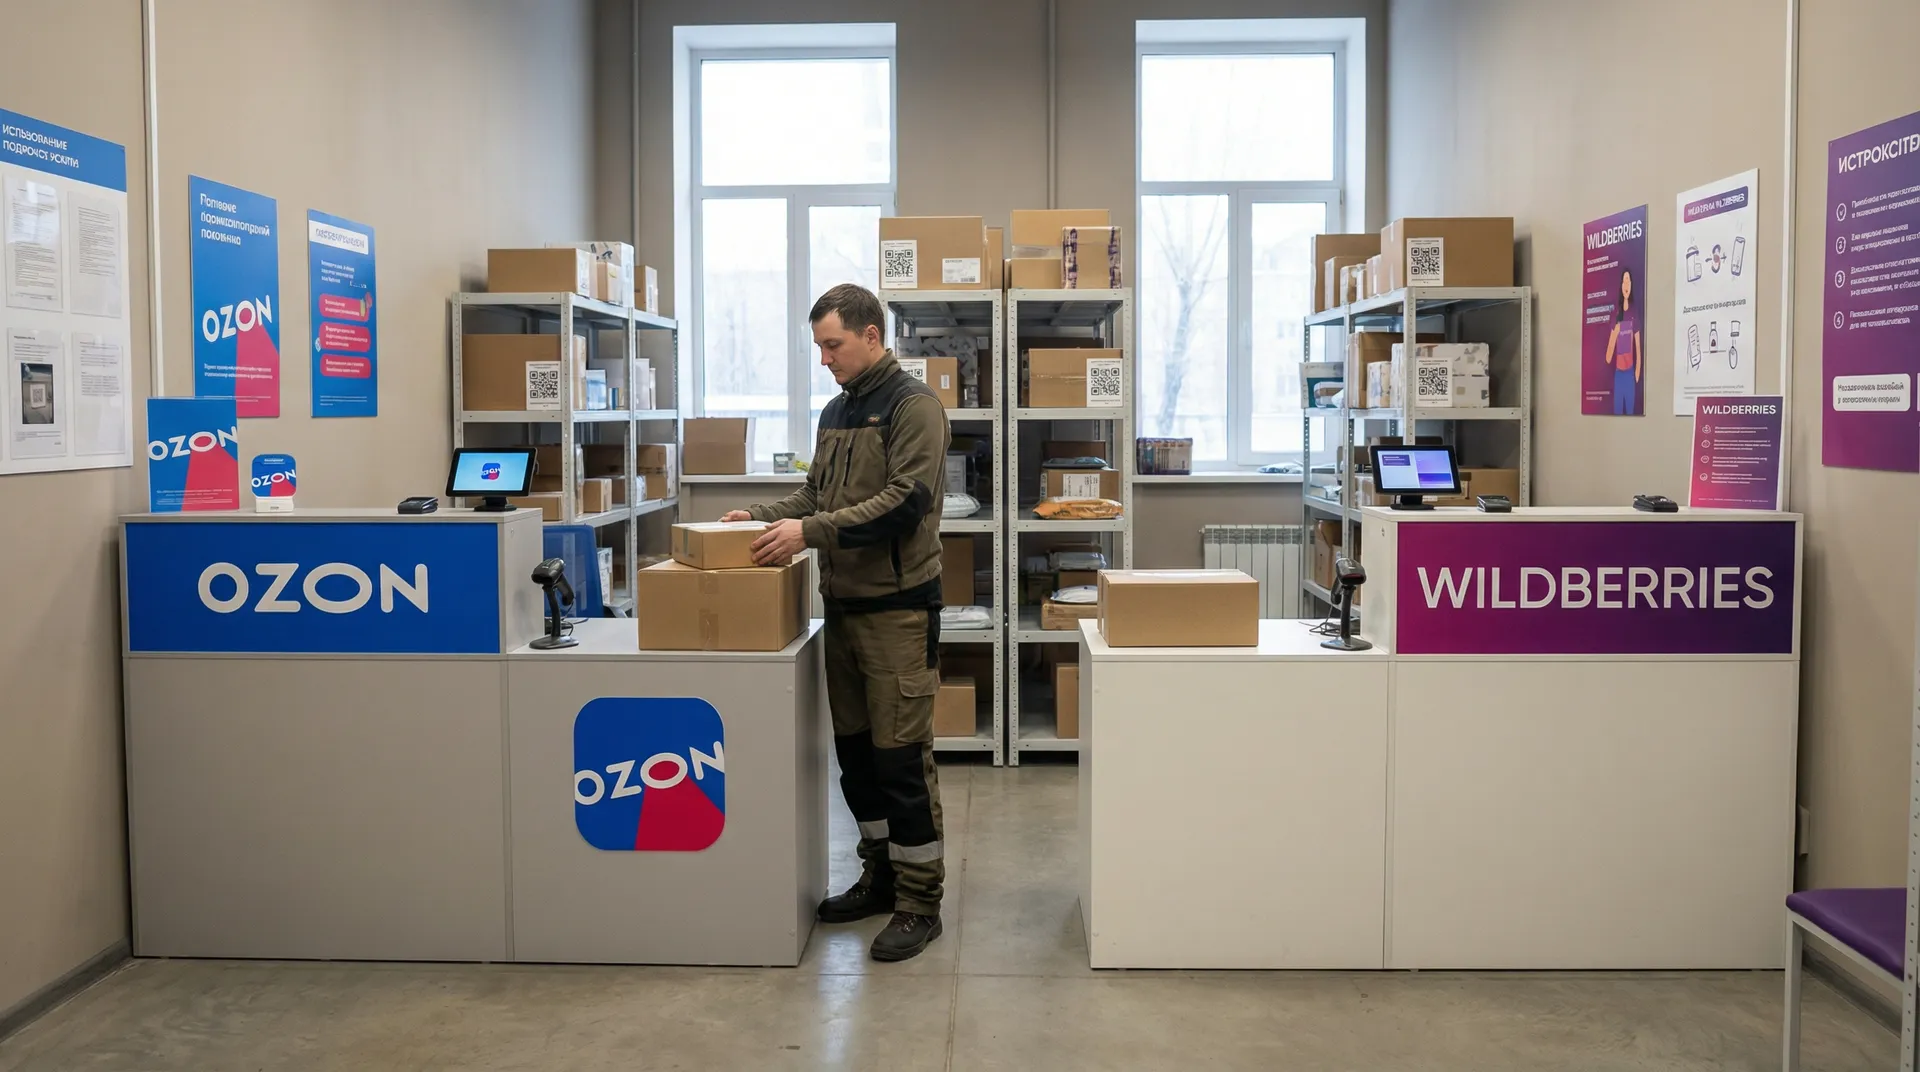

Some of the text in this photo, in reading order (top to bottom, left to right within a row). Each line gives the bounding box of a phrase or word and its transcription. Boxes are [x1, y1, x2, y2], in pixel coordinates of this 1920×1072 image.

[1587, 220, 1642, 250] WILDBERRIES
[203, 295, 272, 342] OZON
[1702, 405, 1776, 415] WILDBERRIES
[147, 426, 238, 461] OZON
[251, 469, 297, 488] OZON
[198, 562, 429, 613] OZON
[1417, 566, 1775, 609] WILDBERRIES
[574, 740, 726, 805] OZON
